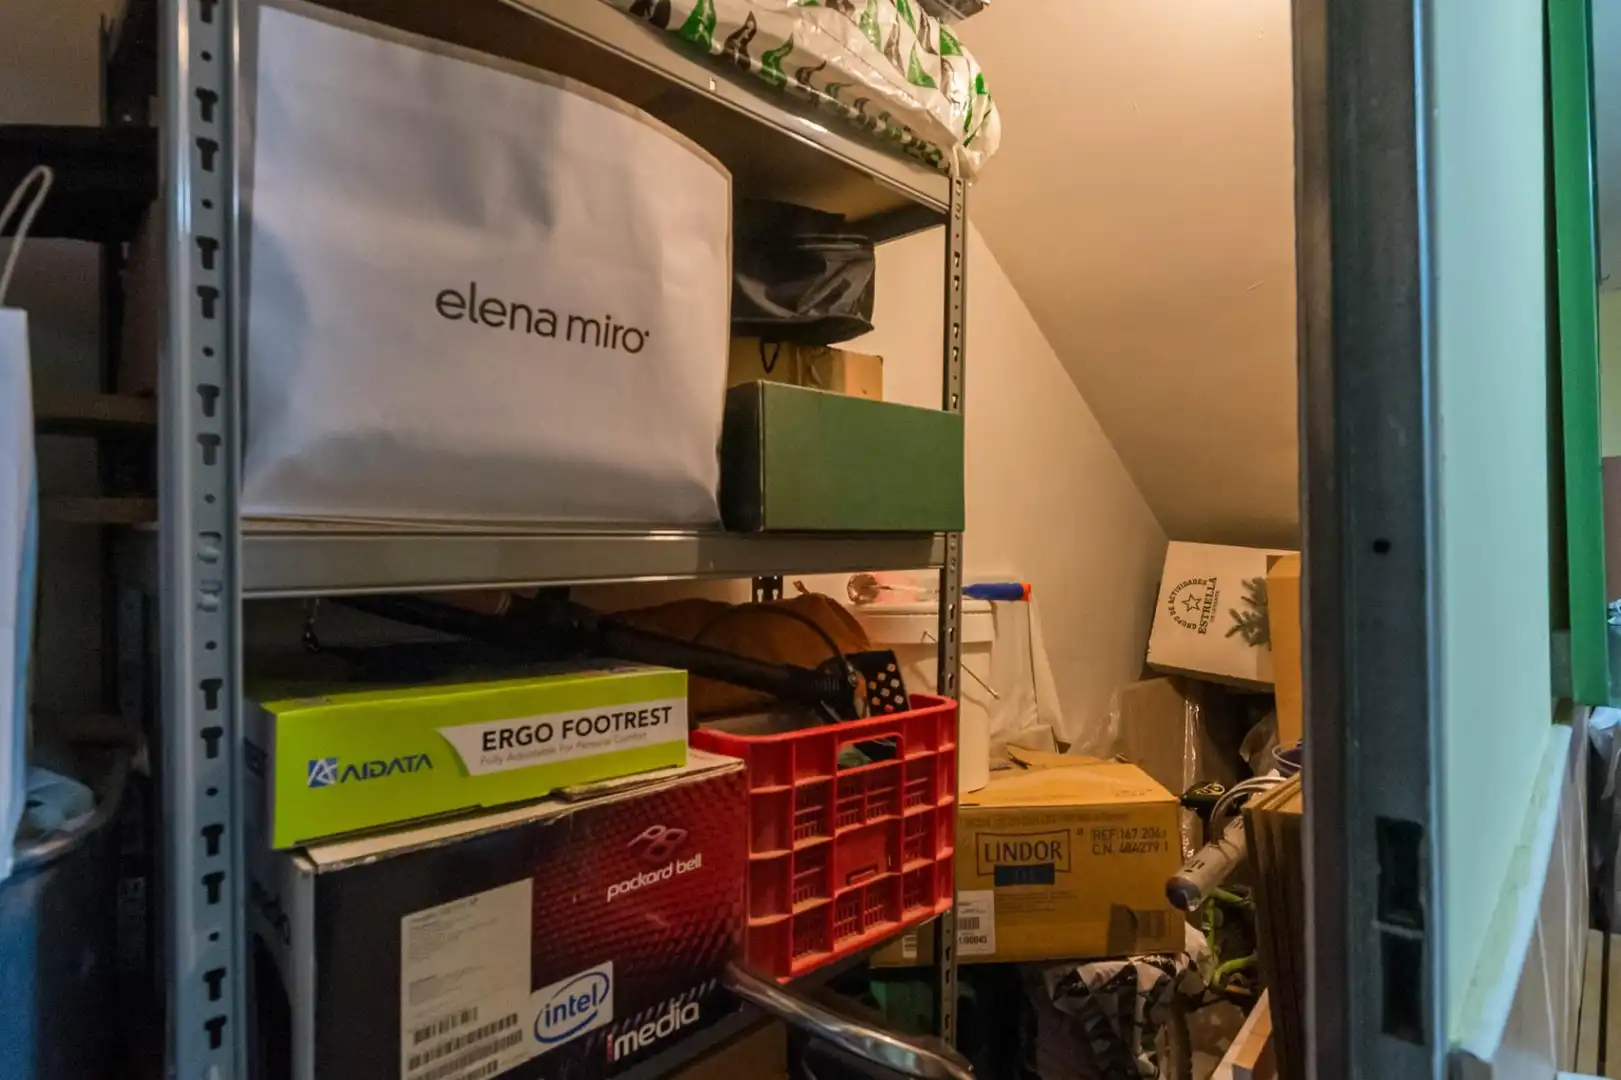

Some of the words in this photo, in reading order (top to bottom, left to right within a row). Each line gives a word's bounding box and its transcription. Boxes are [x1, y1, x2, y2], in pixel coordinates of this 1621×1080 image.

[435, 281, 557, 338] elena
[1197, 577, 1217, 635] ESTRELLA
[482, 722, 554, 751] ERGO
[562, 706, 673, 739] FOOTREST
[341, 753, 434, 783] AIDATA
[984, 840, 1063, 863] LINDOR
[607, 862, 674, 903] packard
[676, 852, 702, 874] bell
[545, 982, 598, 1029] intel
[606, 999, 700, 1062] imedia
